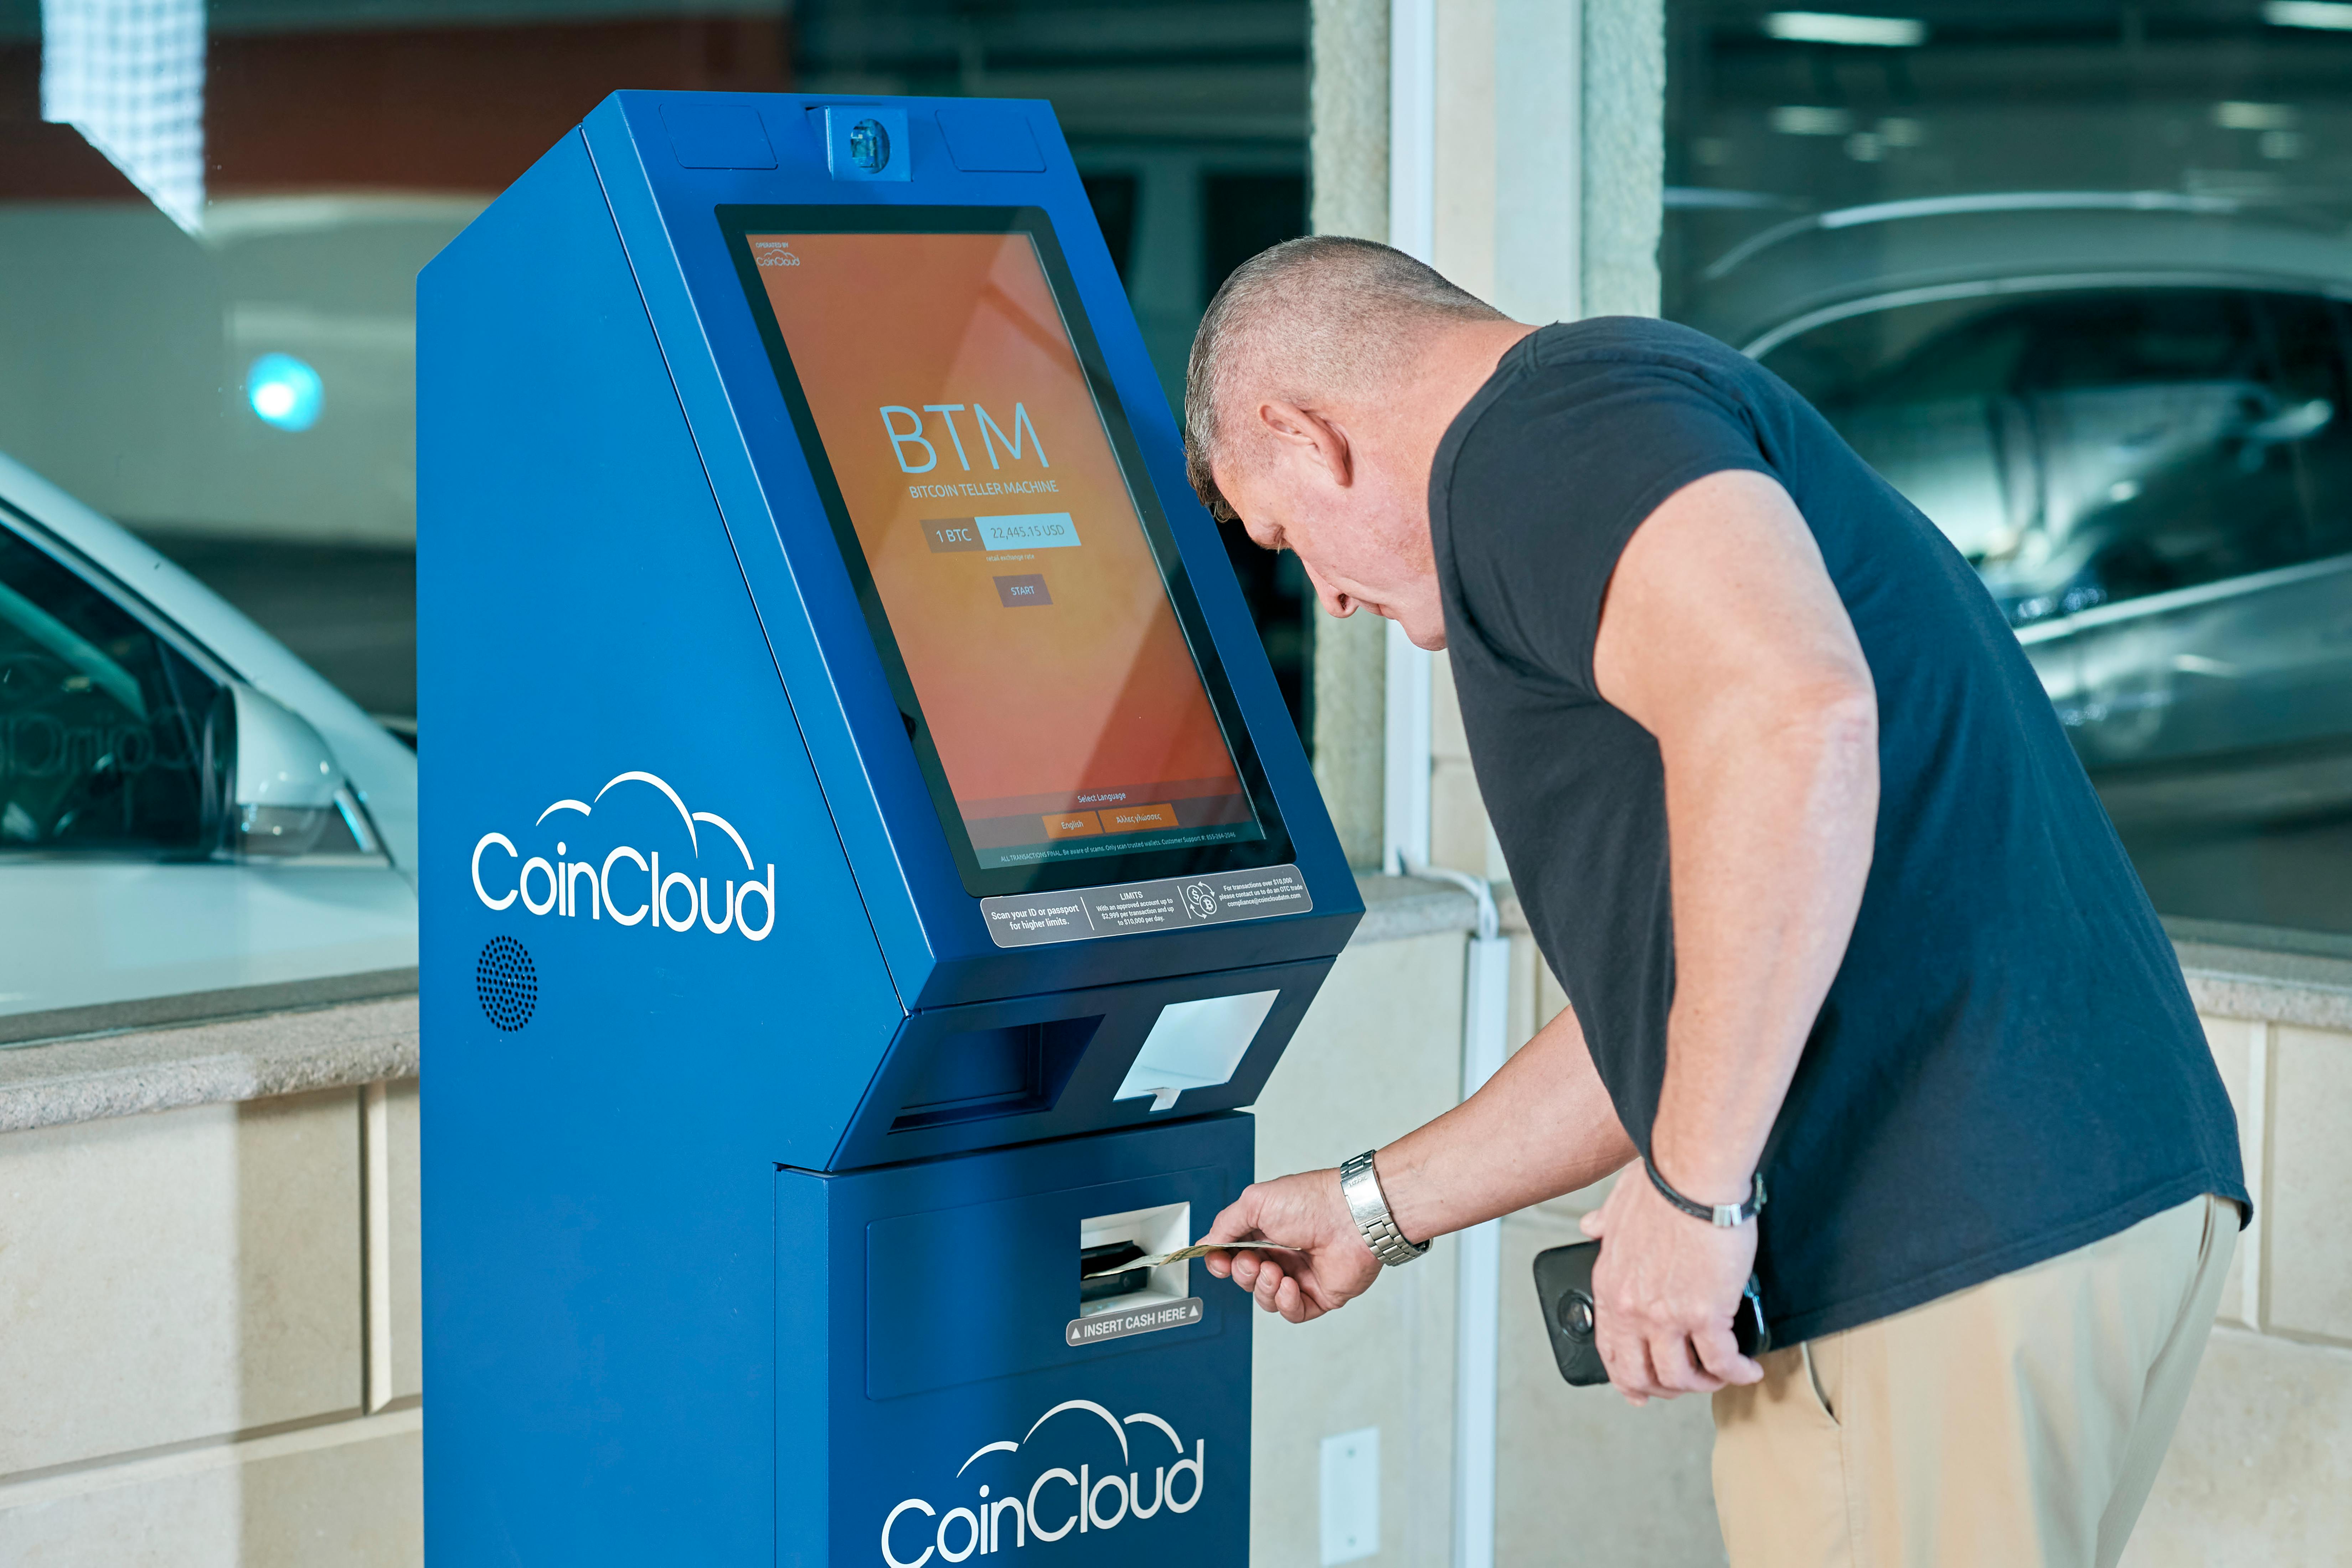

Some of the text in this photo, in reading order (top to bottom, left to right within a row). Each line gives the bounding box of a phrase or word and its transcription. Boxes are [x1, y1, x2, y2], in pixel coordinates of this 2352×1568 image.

[757, 256, 800, 266] CoinCloud
[880, 402, 1049, 473] BTM
[909, 480, 1059, 499] BITCOIN TELLER MACHINE
[936, 525, 1064, 543] 1 BTC 22,445.15 USD
[1011, 586, 1035, 596] START
[1097, 793, 1126, 801] Language
[1061, 820, 1084, 830] English
[1010, 852, 1047, 861] TRANSACTIONS
[471, 832, 775, 941] CoinCloud
[1232, 882, 1262, 890] transactions
[1119, 891, 1143, 900] LIMITS
[1227, 893, 1301, 907] compliance@coincloudatm.com
[991, 911, 1010, 920] Scan
[1011, 910, 1027, 920] your
[1028, 908, 1037, 917] ID
[1046, 904, 1080, 916] passport
[1116, 902, 1140, 911] approved
[1010, 917, 1069, 930] for higher limits.
[1124, 917, 1145, 925] $10,000
[1084, 1307, 1186, 1337] INSERT CASH HERE
[881, 1439, 1204, 1568] CoinCloud
